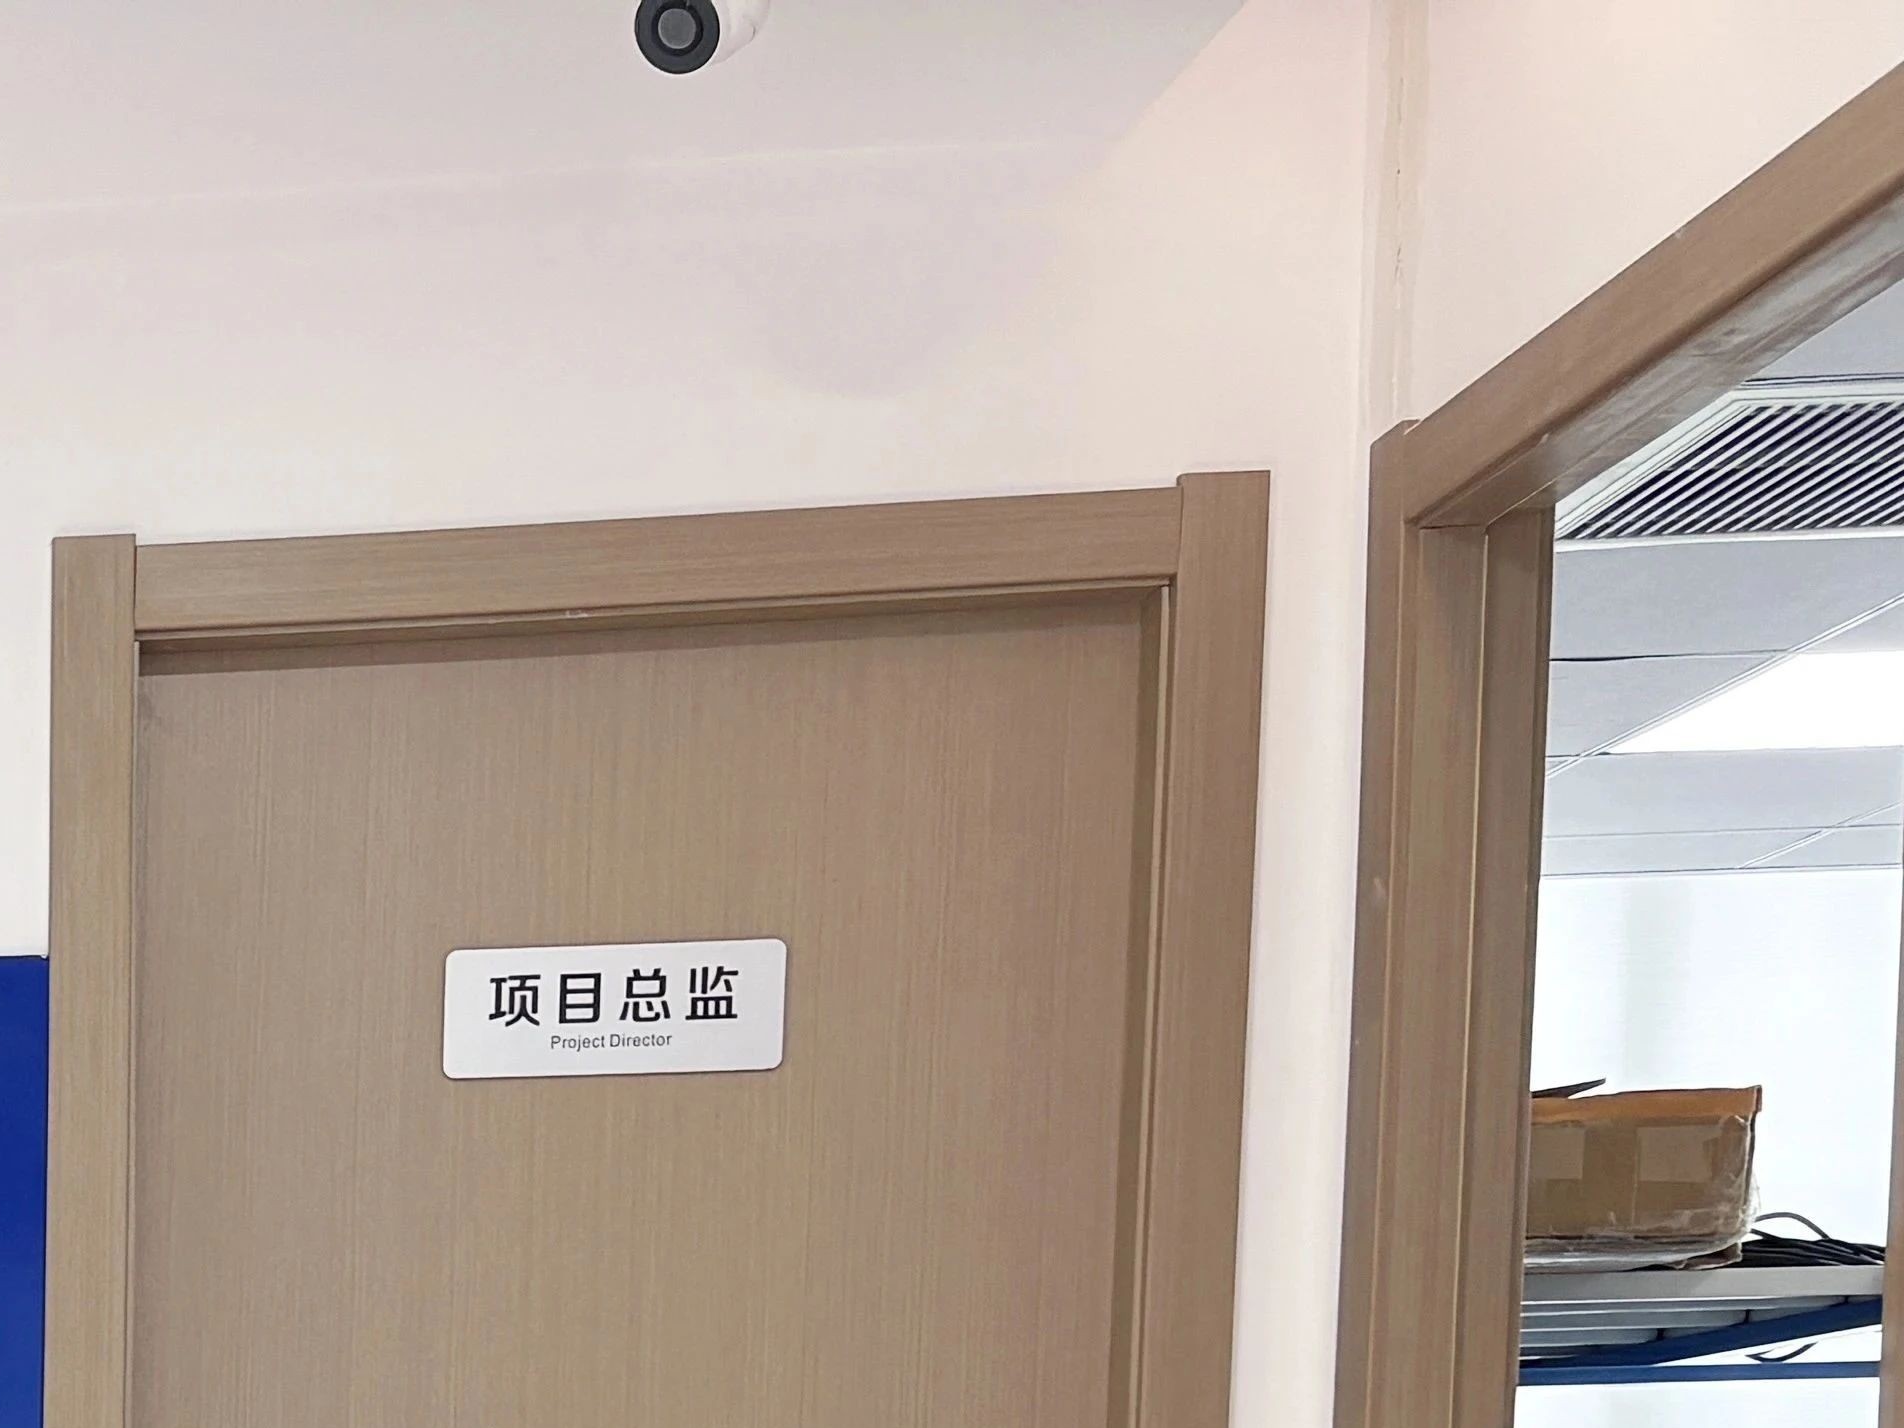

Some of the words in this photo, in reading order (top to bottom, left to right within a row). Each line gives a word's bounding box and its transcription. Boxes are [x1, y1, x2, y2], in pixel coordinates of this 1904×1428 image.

[489, 966, 739, 1027] 项目总监
[550, 1034, 605, 1051] Project
[610, 1033, 672, 1048] Director
